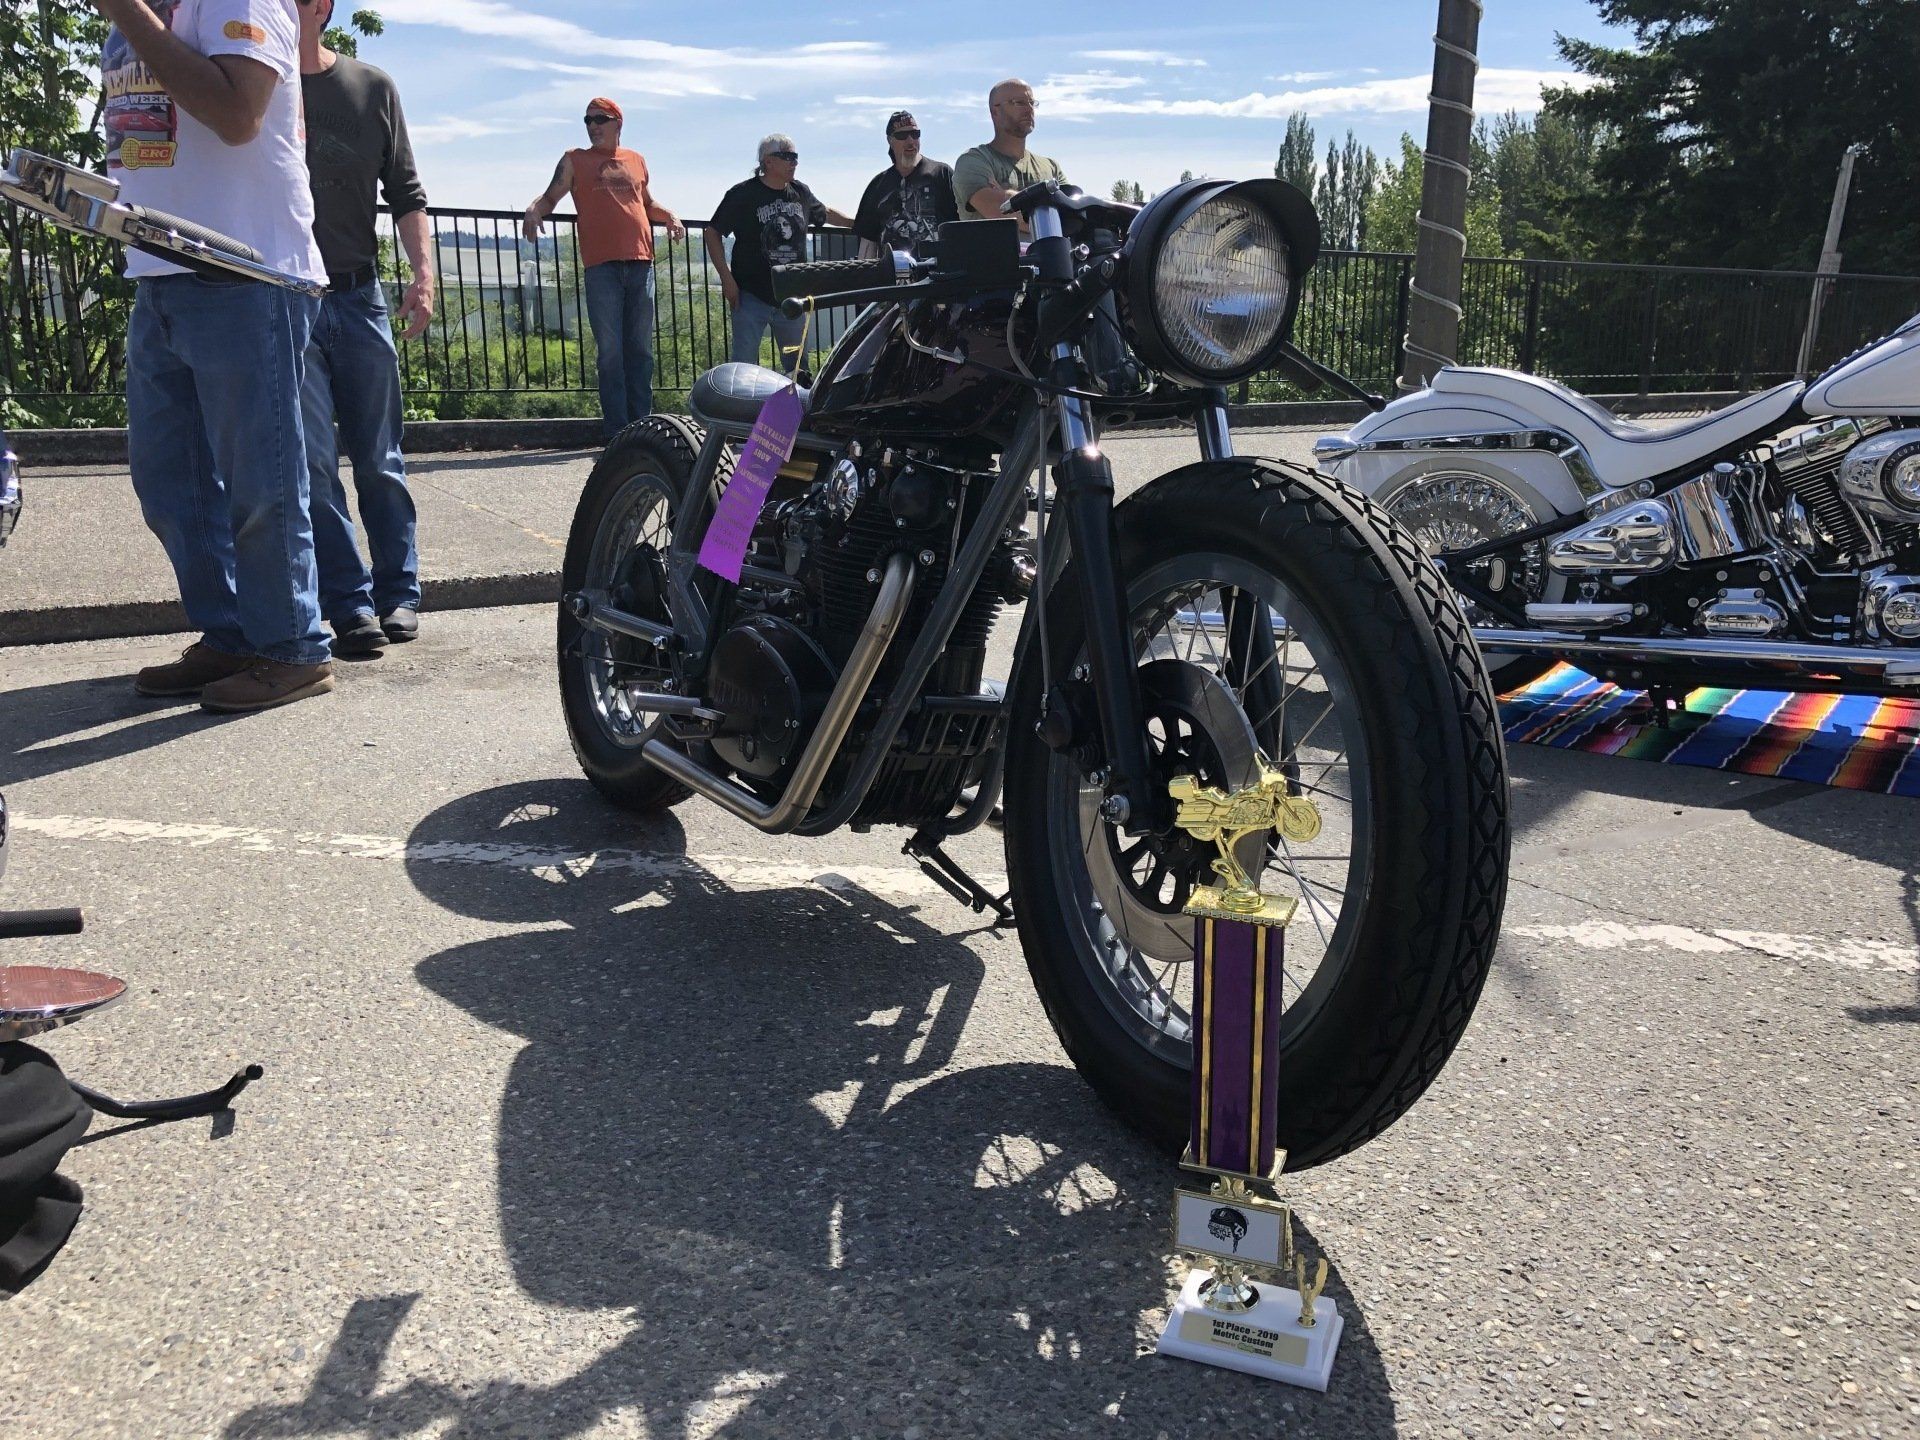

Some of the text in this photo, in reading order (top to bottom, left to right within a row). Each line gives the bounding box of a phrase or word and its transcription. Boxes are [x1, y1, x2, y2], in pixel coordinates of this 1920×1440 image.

[140, 149, 170, 158] ERC
[753, 448, 771, 462] SHOW
[1212, 1319, 1225, 1329] 1st
[1226, 1322, 1251, 1335] Place
[1257, 1329, 1279, 1341] 2019
[1213, 1328, 1240, 1341] Metric
[1241, 1335, 1274, 1349] Custom
